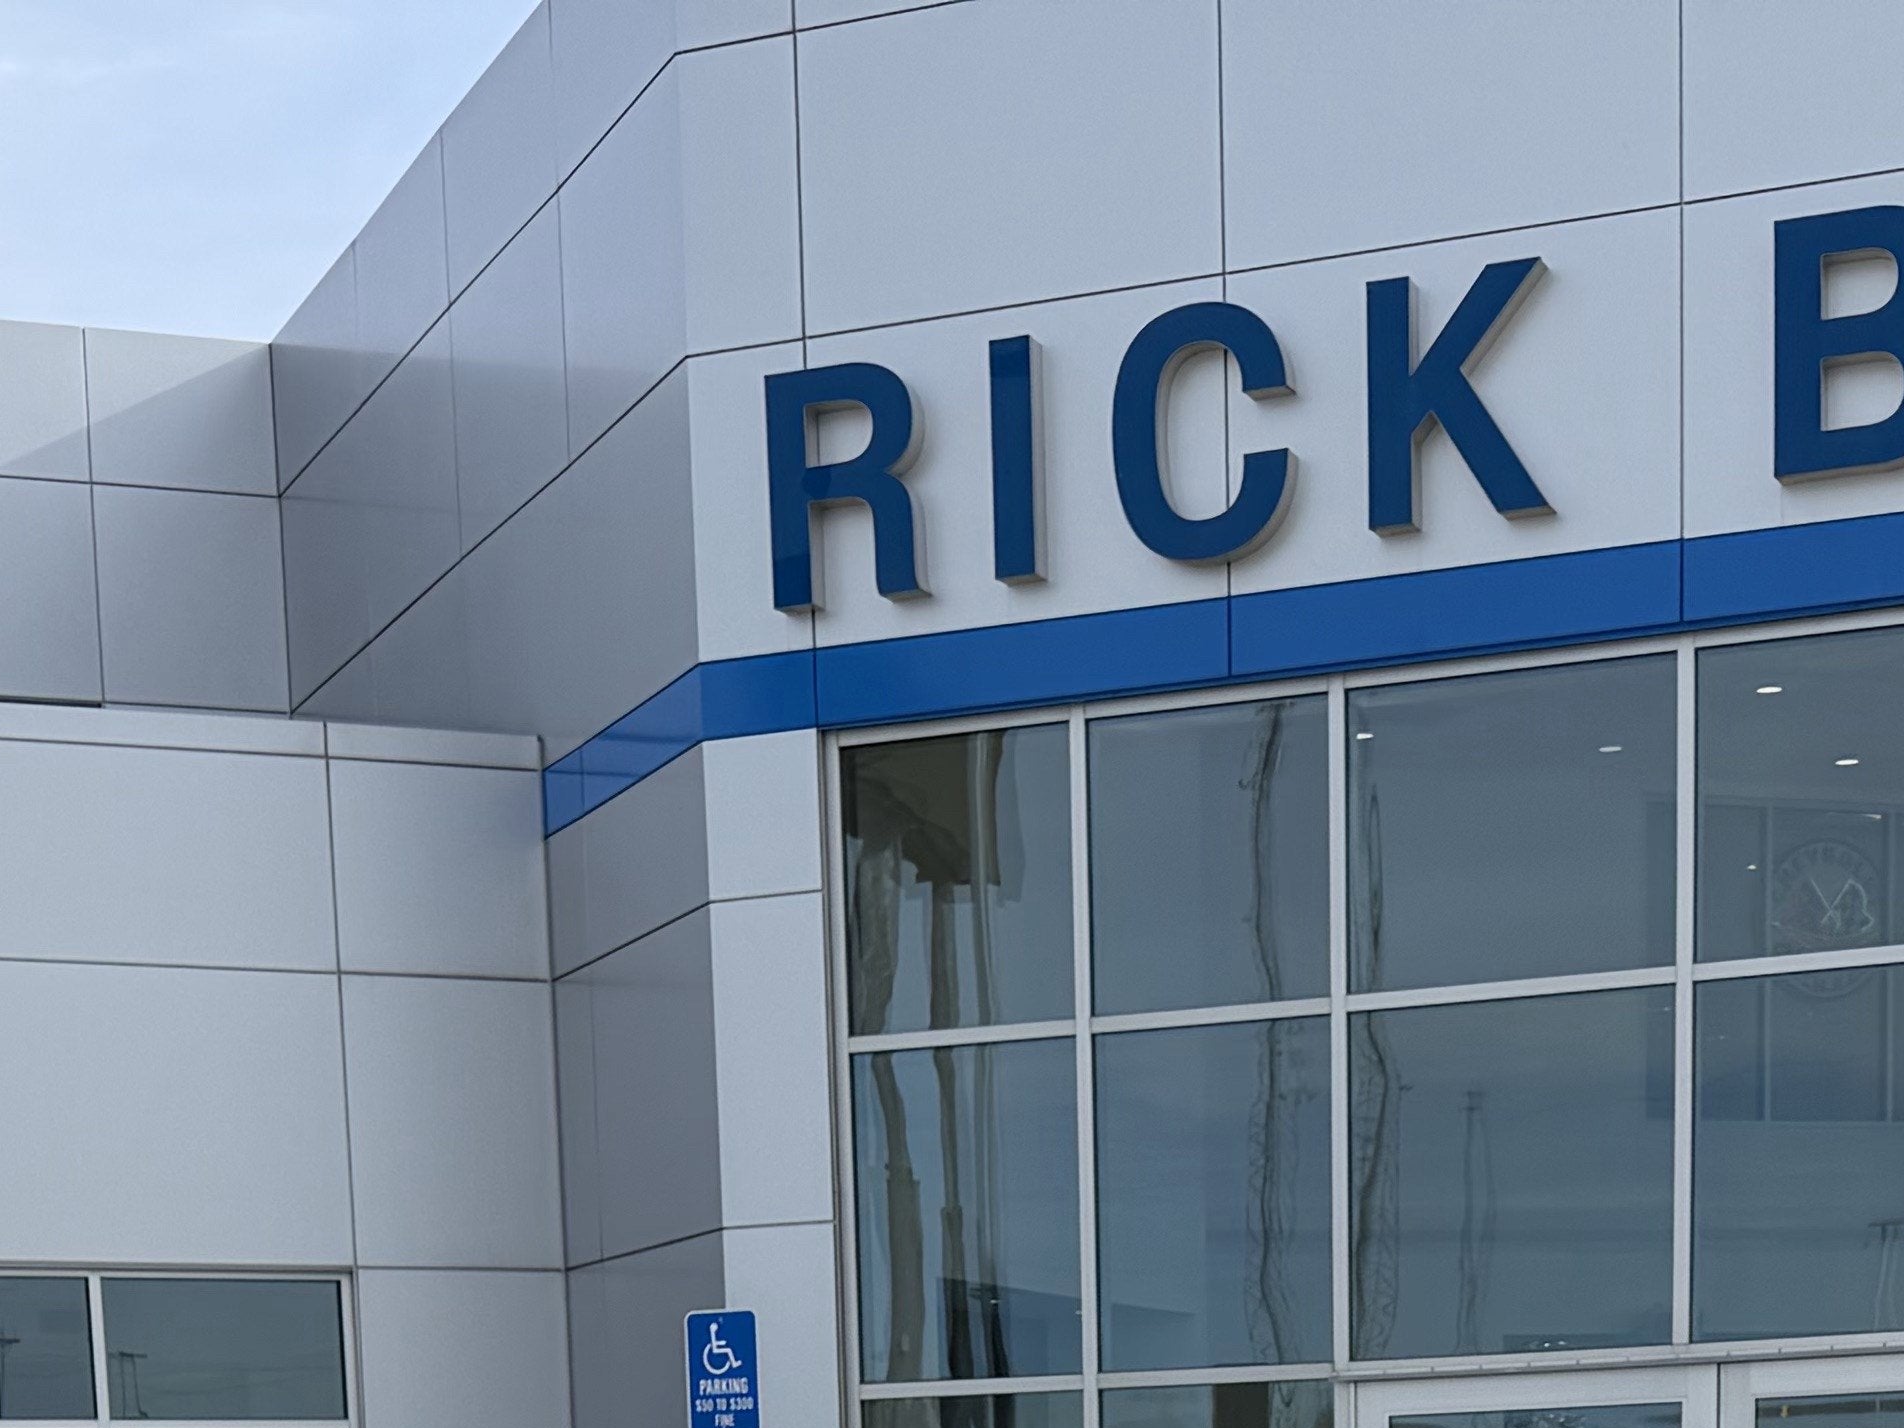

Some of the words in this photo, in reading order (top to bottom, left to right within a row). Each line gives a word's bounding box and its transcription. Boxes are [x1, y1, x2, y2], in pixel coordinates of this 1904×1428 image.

[762, 256, 1556, 612] RICK
[699, 1377, 749, 1396] PARKING
[716, 1398, 727, 1411] TO
[715, 1414, 735, 1428] FINE
